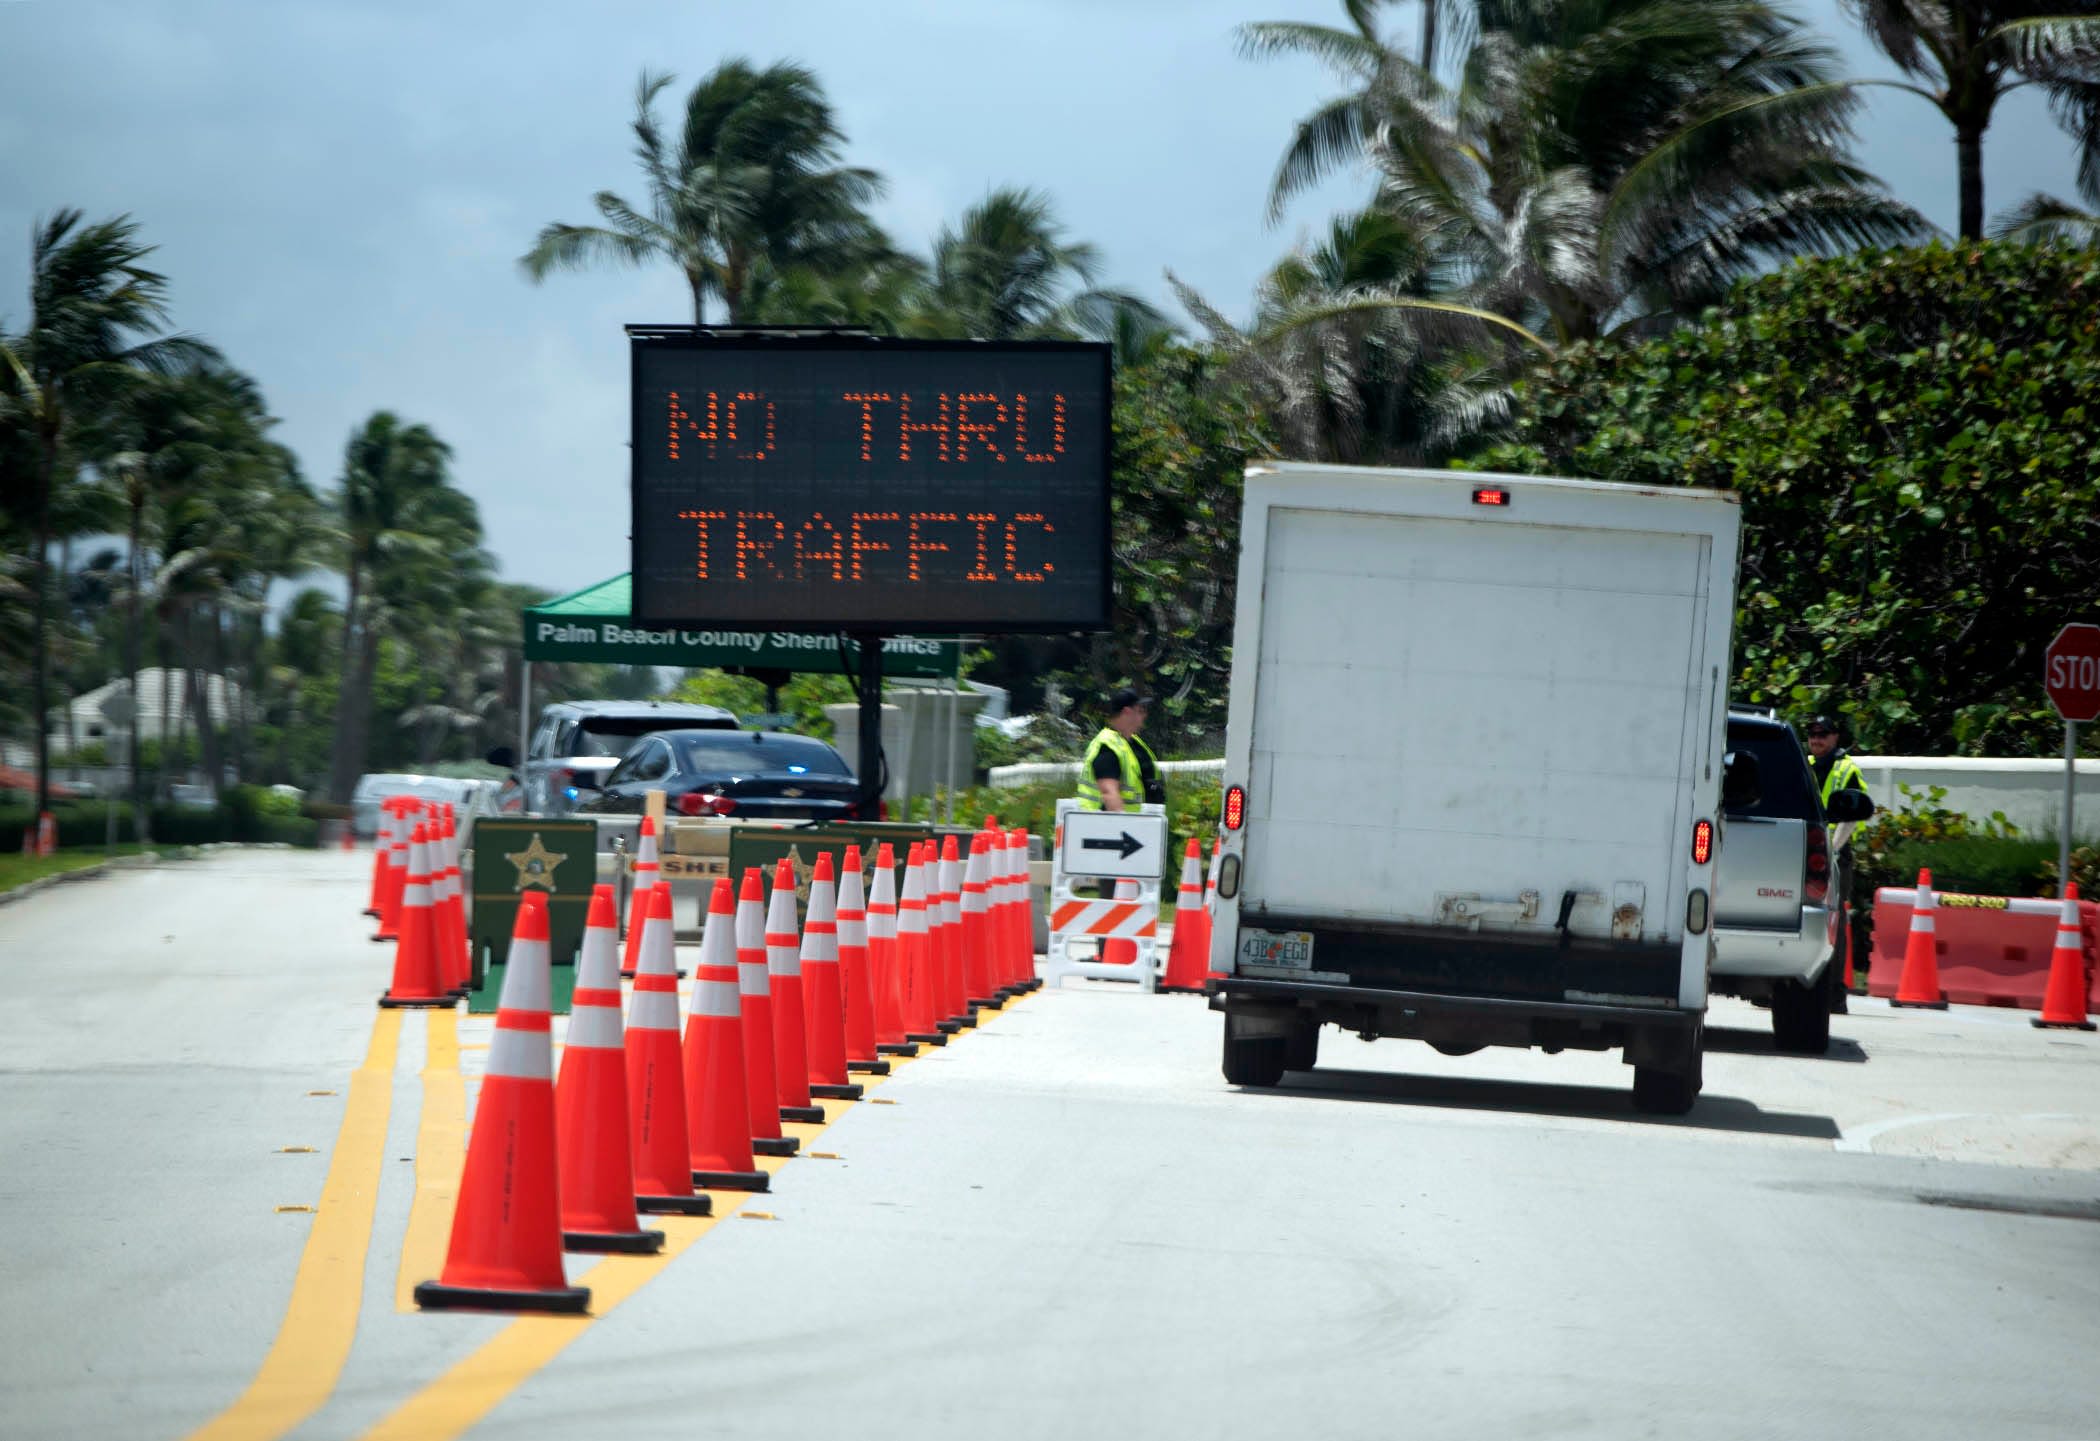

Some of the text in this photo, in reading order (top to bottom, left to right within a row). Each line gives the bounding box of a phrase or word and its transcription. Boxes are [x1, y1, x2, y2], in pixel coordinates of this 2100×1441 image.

[667, 390, 1066, 463] NO THRU
[677, 510, 1056, 582] TRAFFIC
[537, 622, 597, 644] Palm
[2050, 654, 2100, 691] STO
[1757, 887, 1793, 899] GMC
